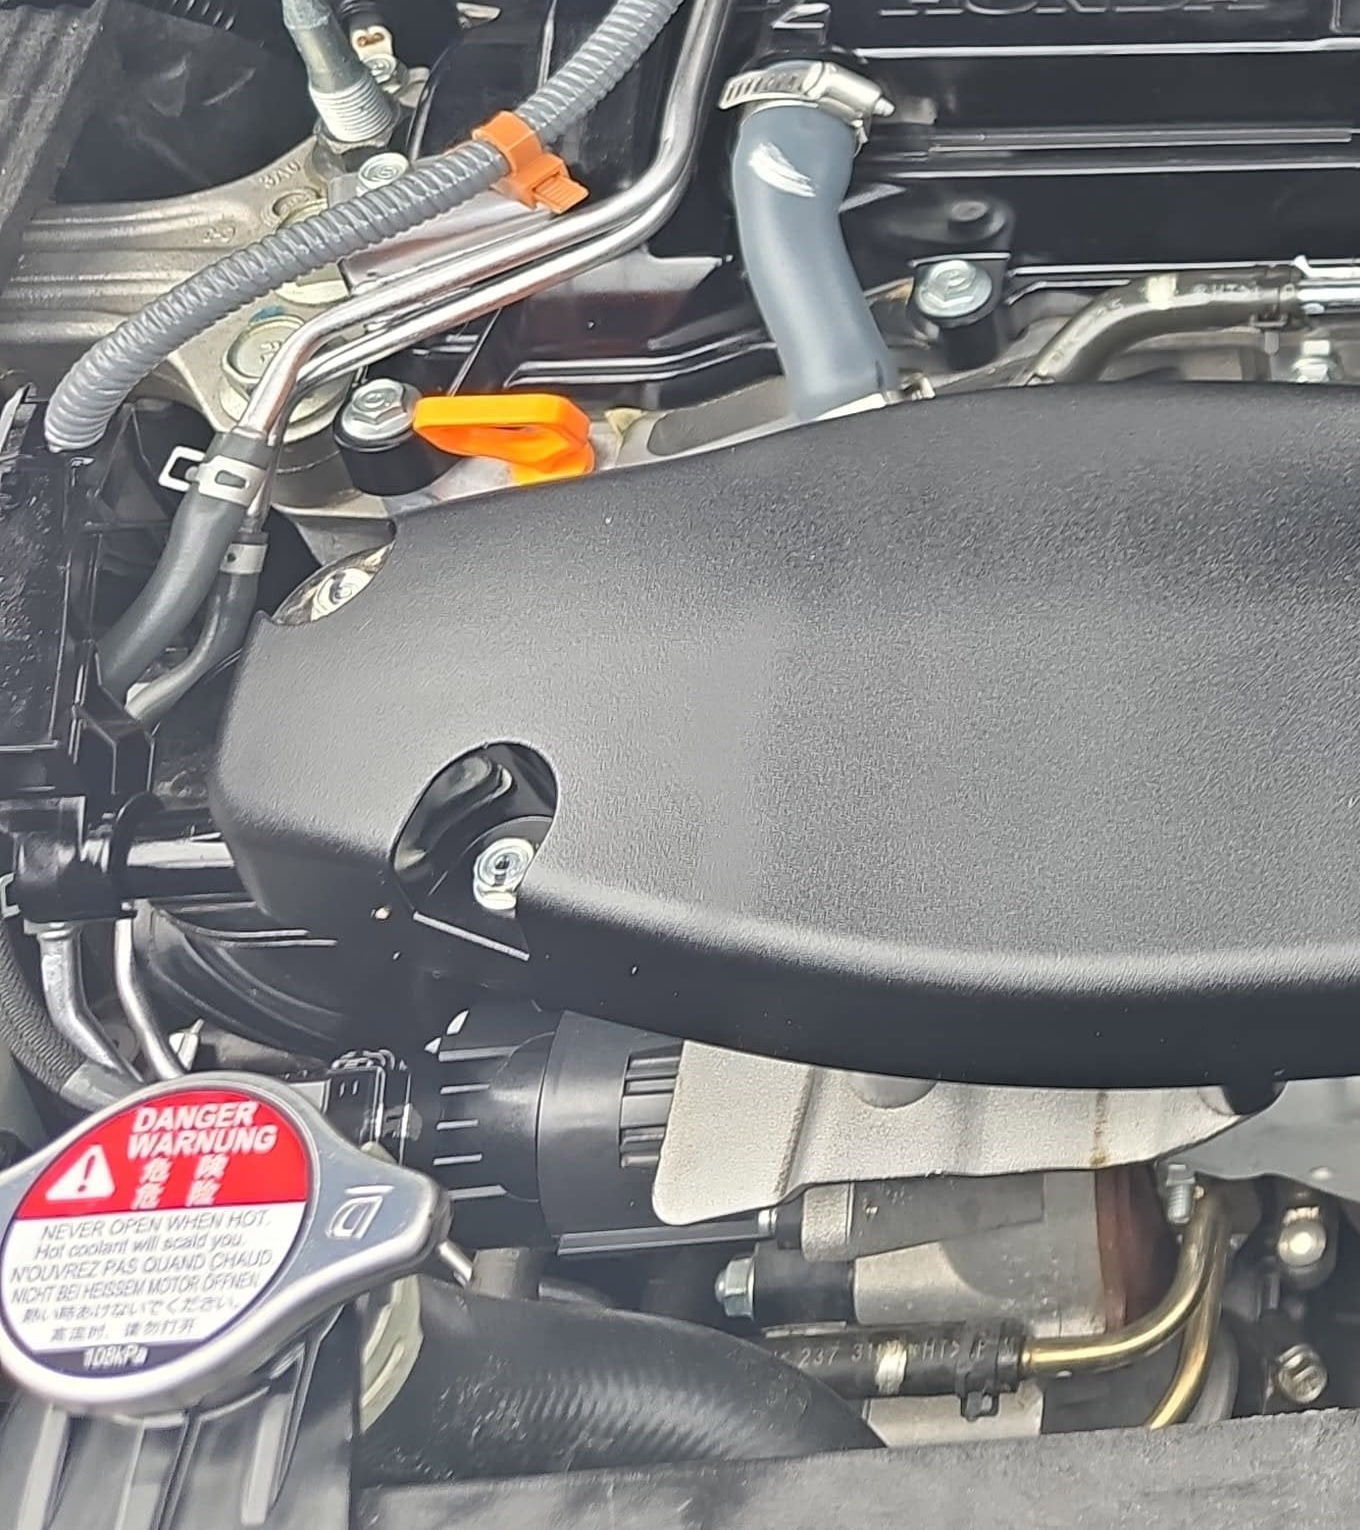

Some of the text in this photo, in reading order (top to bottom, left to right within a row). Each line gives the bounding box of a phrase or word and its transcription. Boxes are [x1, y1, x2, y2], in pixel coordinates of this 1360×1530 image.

[132, 1101, 258, 1132] DANGER
[128, 1125, 278, 1160] WARNUNG
[42, 1220, 105, 1241] NEVER
[110, 1216, 161, 1236] OPEN
[167, 1212, 223, 1231] WHEN
[34, 1243, 66, 1260] Hot
[68, 1237, 129, 1259] coolant
[133, 1234, 160, 1252] will
[163, 1231, 208, 1251] scald
[10, 1248, 273, 1284] N'OUVREZ PAS QUAND CHAUD
[11, 1284, 55, 1304] NICHT
[57, 1282, 81, 1302] BEI
[82, 1278, 147, 1299] HEISSEM
[147, 1273, 200, 1295] MOTOR
[798, 1346, 839, 1369] 237
